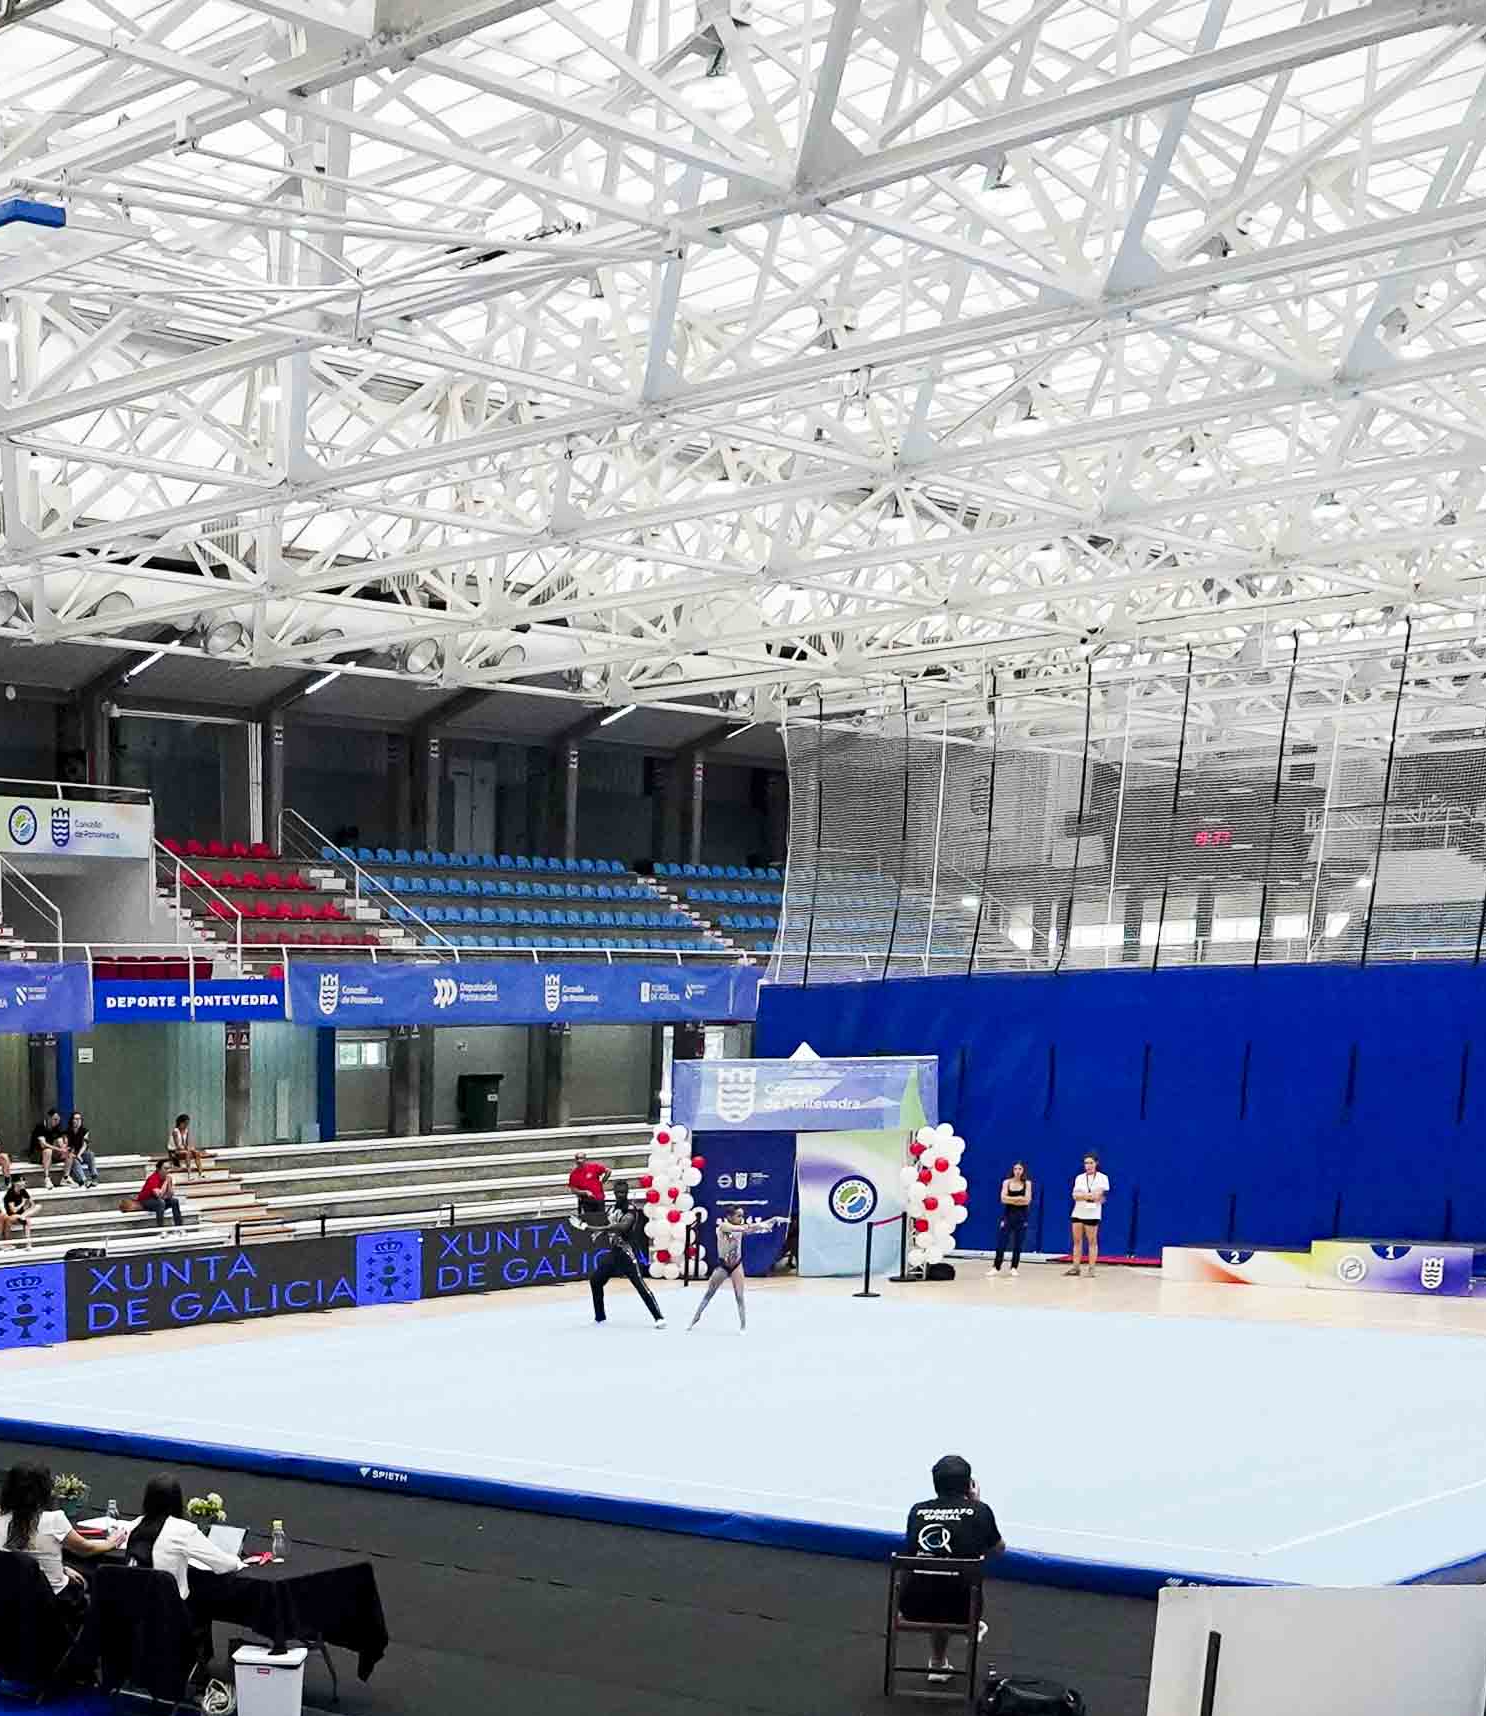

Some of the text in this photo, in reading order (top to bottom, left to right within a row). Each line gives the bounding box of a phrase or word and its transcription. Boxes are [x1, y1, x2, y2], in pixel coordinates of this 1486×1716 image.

[106, 994, 278, 1008] DEPORTE PONTEVEDRA
[439, 1223, 573, 1258] XUNTA
[1230, 1251, 1239, 1264] 2
[90, 1252, 258, 1295] XUNTA
[437, 1262, 486, 1291] DE
[86, 1277, 357, 1332] DE GALICIA
[371, 1469, 408, 1483] SPIETH
